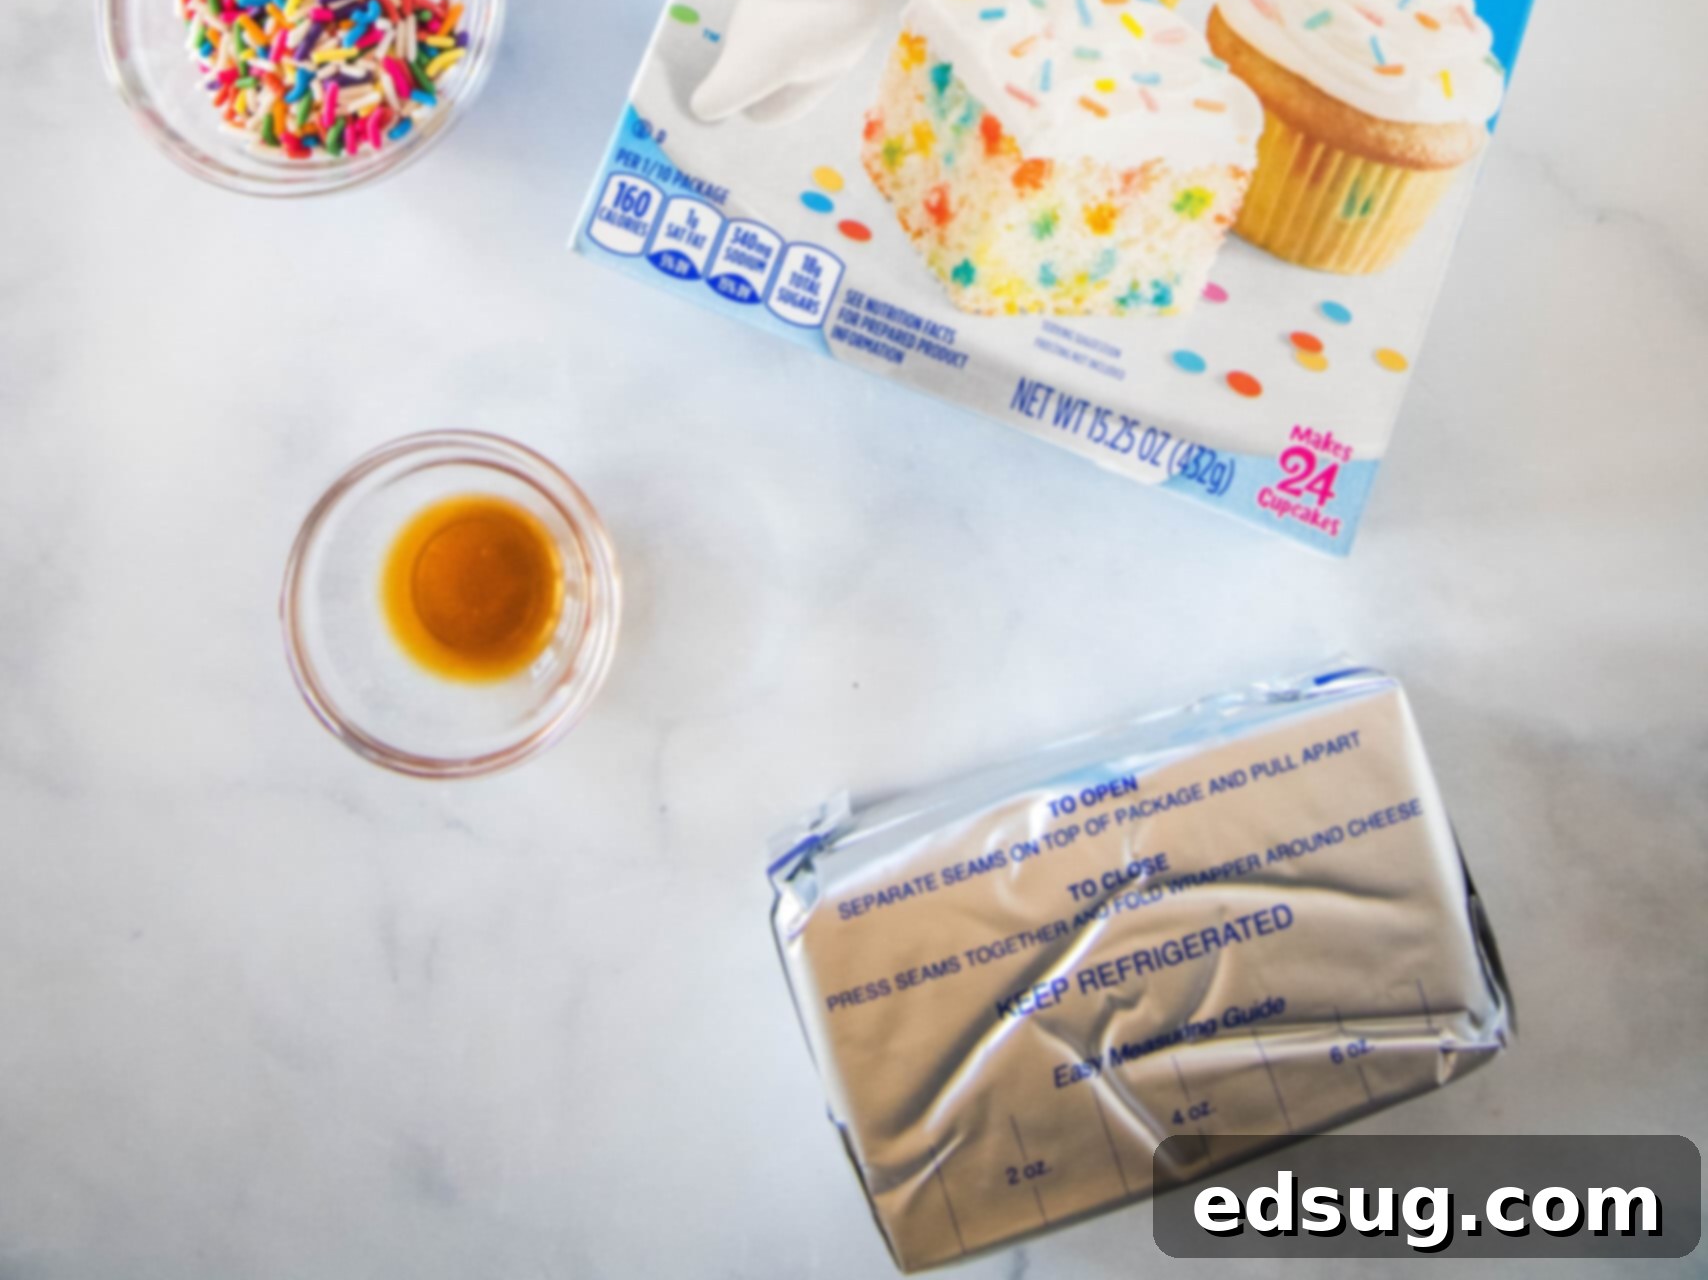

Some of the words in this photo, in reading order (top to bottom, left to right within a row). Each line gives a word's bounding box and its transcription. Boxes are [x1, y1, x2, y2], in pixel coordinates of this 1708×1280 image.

[613, 181, 652, 218] 160
[615, 148, 641, 170] PER
[671, 169, 729, 205] PACKAGE
[599, 206, 650, 238] CALORIES
[665, 222, 686, 242] SAT
[685, 231, 707, 250] FAT
[778, 286, 819, 315] SUGARS
[789, 271, 821, 297] TOTAL
[838, 306, 860, 326] FOR
[860, 316, 916, 349] PREPARED
[916, 338, 969, 370] PRODUCT
[845, 289, 866, 308] SEE
[864, 298, 923, 331] NUTRITION
[923, 320, 956, 345] FACTS
[831, 325, 905, 365] INFORMATION
[1010, 377, 1055, 420] NET
[1053, 392, 1091, 434] WT
[1086, 406, 1140, 454] 15.25
[1137, 426, 1171, 467] OZ
[1167, 439, 1236, 497] (432g)
[1289, 424, 1353, 463] Makes
[1276, 444, 1339, 507] 24
[1257, 486, 1341, 537] Cupcakes
[1047, 793, 1074, 819] TO
[1079, 774, 1139, 808] OPEN
[837, 871, 939, 921] SEPARATE
[940, 845, 1008, 887] SEAMS
[1009, 839, 1040, 863] ON
[1041, 822, 1081, 852] TOP
[1084, 812, 1111, 837] OF
[1115, 783, 1205, 827] PACKAGE
[1208, 768, 1248, 797] AND
[1250, 753, 1299, 785] PULL
[1301, 730, 1362, 765] APART
[1067, 878, 1098, 903] TO
[1100, 853, 1171, 893] CLOSE
[826, 978, 892, 1013] PRESS
[894, 955, 962, 992] SEAMS
[964, 918, 1070, 969] TOGETHER
[1072, 901, 1110, 933] AND
[1113, 883, 1164, 914] FOLD
[1169, 853, 1262, 894] WRAPPER
[1265, 824, 1345, 866] AROUND
[1347, 797, 1424, 839] CHEESE
[995, 977, 1070, 1022] KEEP
[1076, 903, 1294, 997] REFRIGERATED
[1053, 1053, 1107, 1090] Easy
[1109, 1016, 1219, 1070] Measuring
[1222, 996, 1287, 1030] Guide
[1329, 1044, 1345, 1064] 6
[1345, 1038, 1375, 1060] oz.
[1171, 1108, 1184, 1126] 4
[1187, 1100, 1217, 1122] oz.
[1006, 1166, 1020, 1186] 2
[1023, 1159, 1053, 1181] oz.
